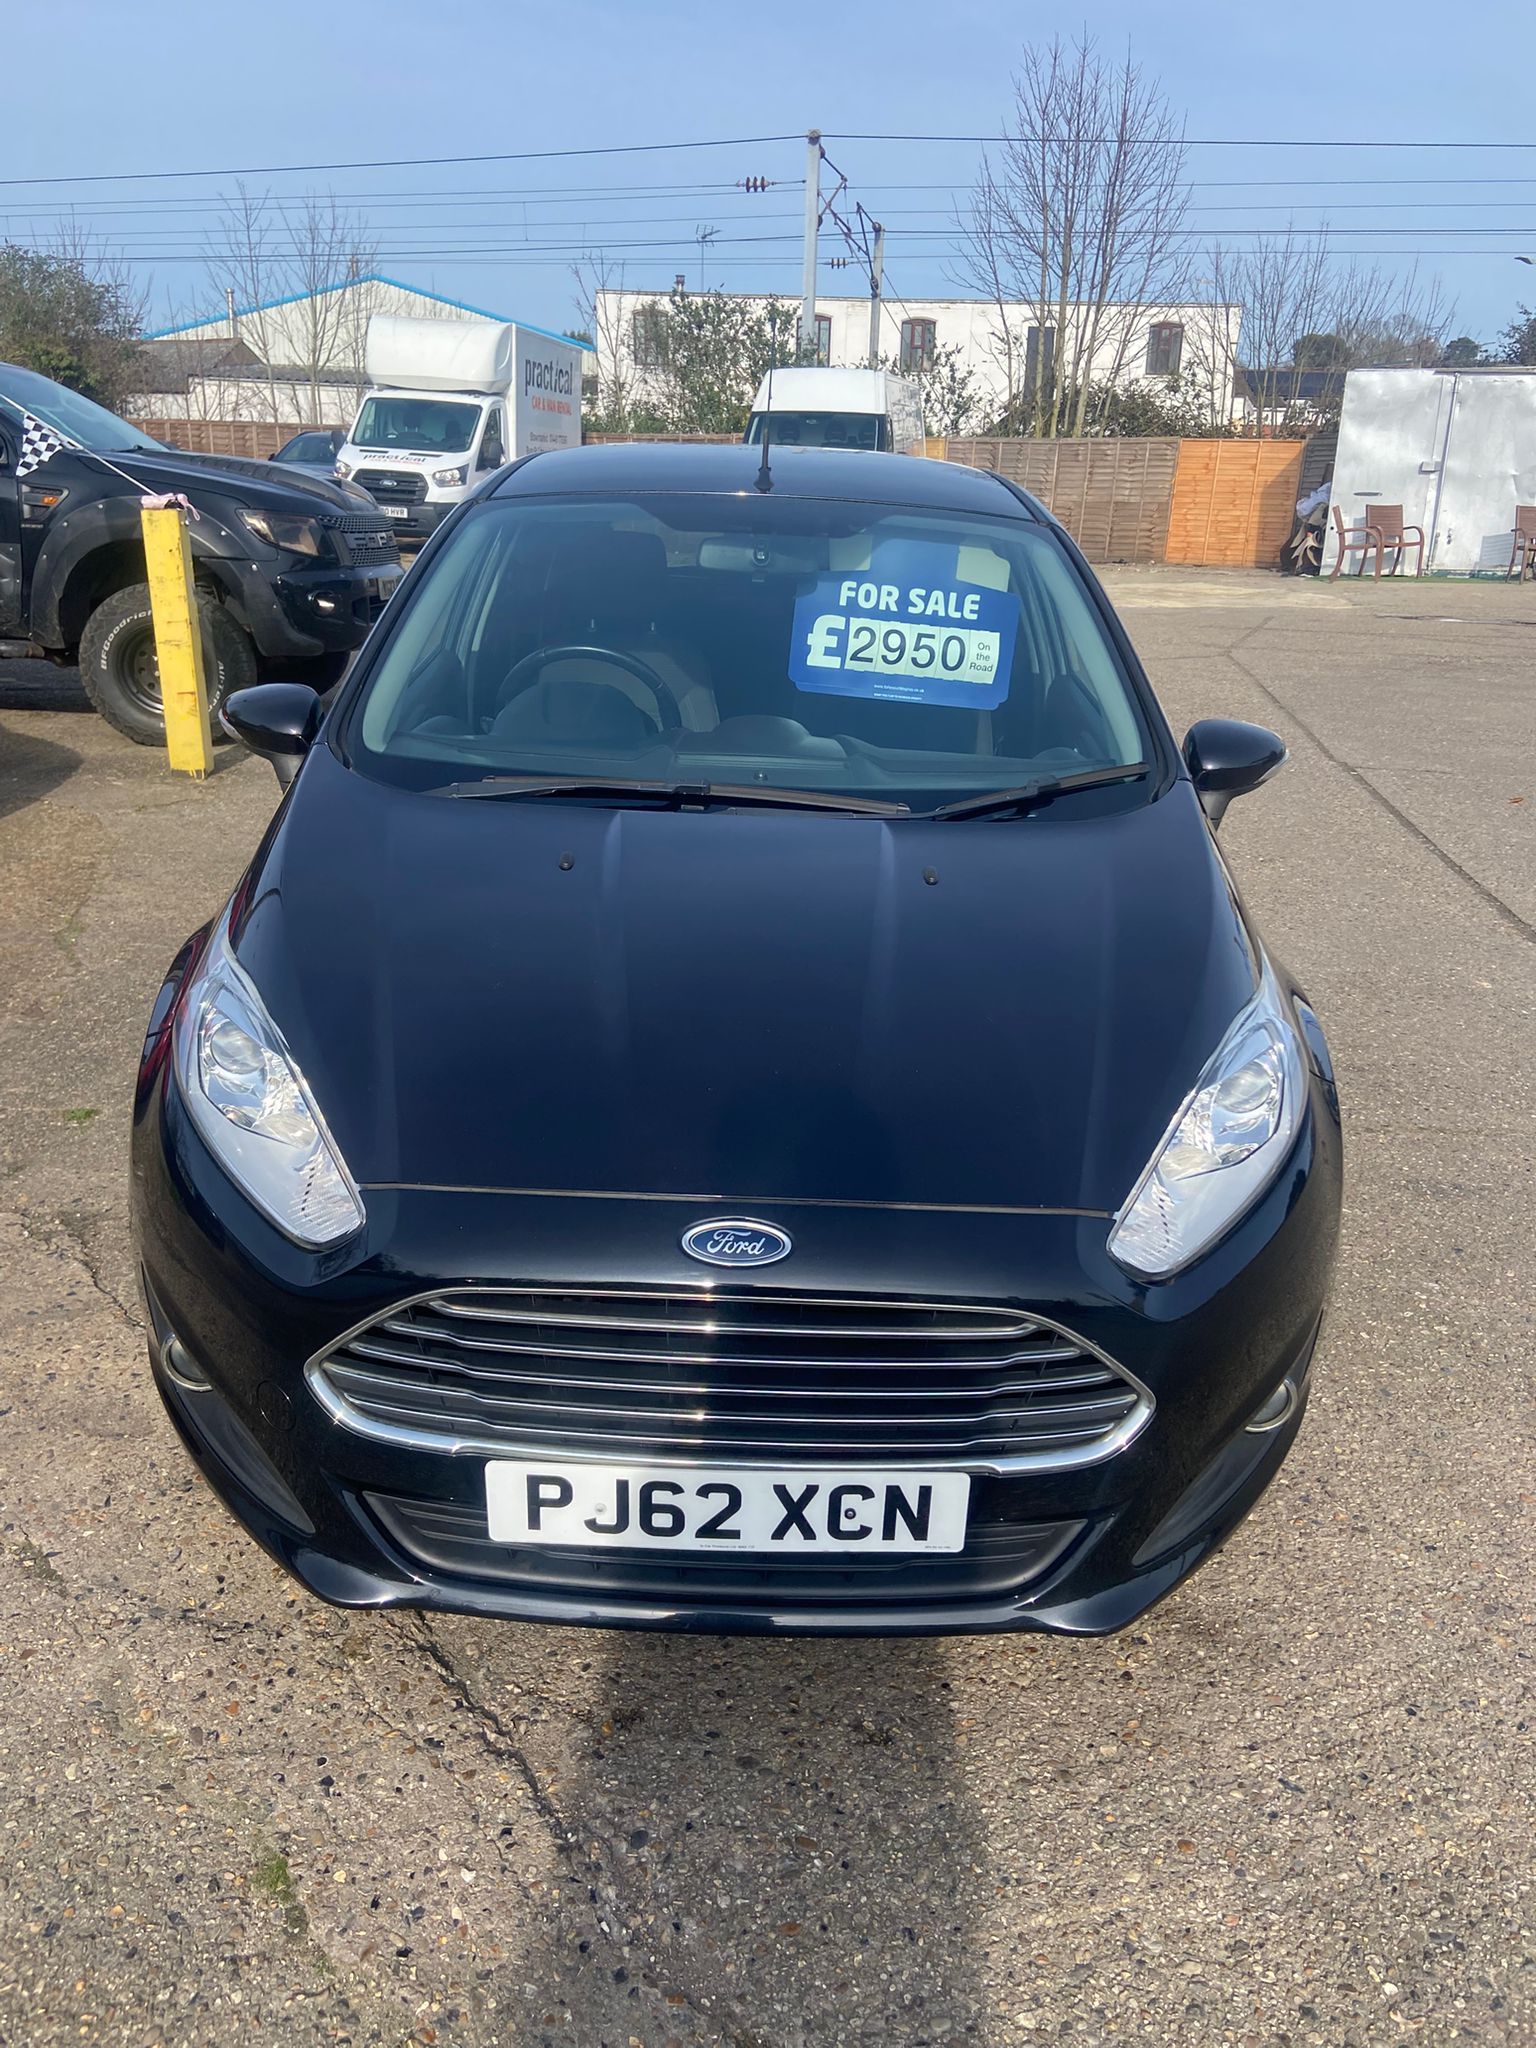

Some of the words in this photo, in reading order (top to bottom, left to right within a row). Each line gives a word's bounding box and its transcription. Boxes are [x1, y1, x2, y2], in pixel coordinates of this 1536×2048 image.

[525, 358, 573, 397] practical
[363, 453, 427, 463] practical
[839, 580, 900, 612] FOR
[907, 587, 981, 620] SALE
[806, 614, 966, 672] £2950
[977, 641, 991, 651] On
[969, 662, 993, 673] Road
[975, 652, 991, 662] the
[706, 1229, 766, 1255] Ford
[525, 1473, 742, 1540] PJ62
[770, 1483, 933, 1541] XCN
